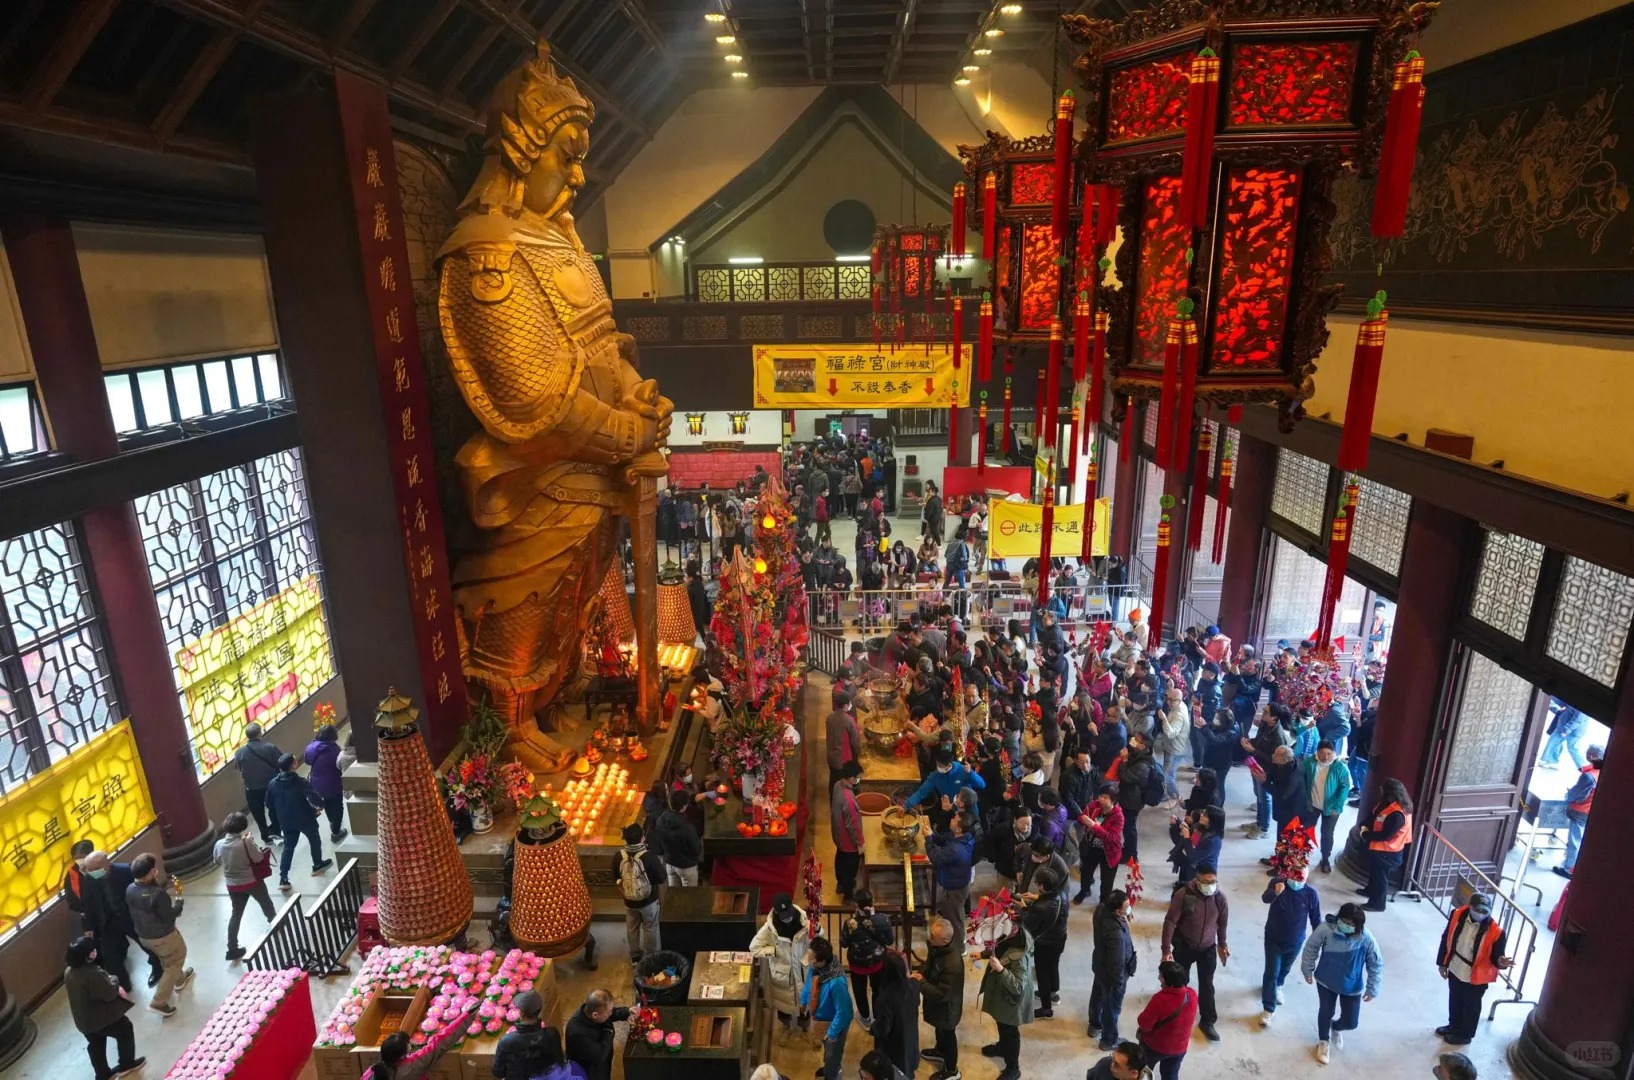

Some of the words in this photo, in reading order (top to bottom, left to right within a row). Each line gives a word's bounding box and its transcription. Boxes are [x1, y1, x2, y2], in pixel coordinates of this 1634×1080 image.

[850, 379, 912, 395] 不設奉香
[222, 610, 287, 665] 福祿宮
[2, 773, 127, 871] 吉星高照
